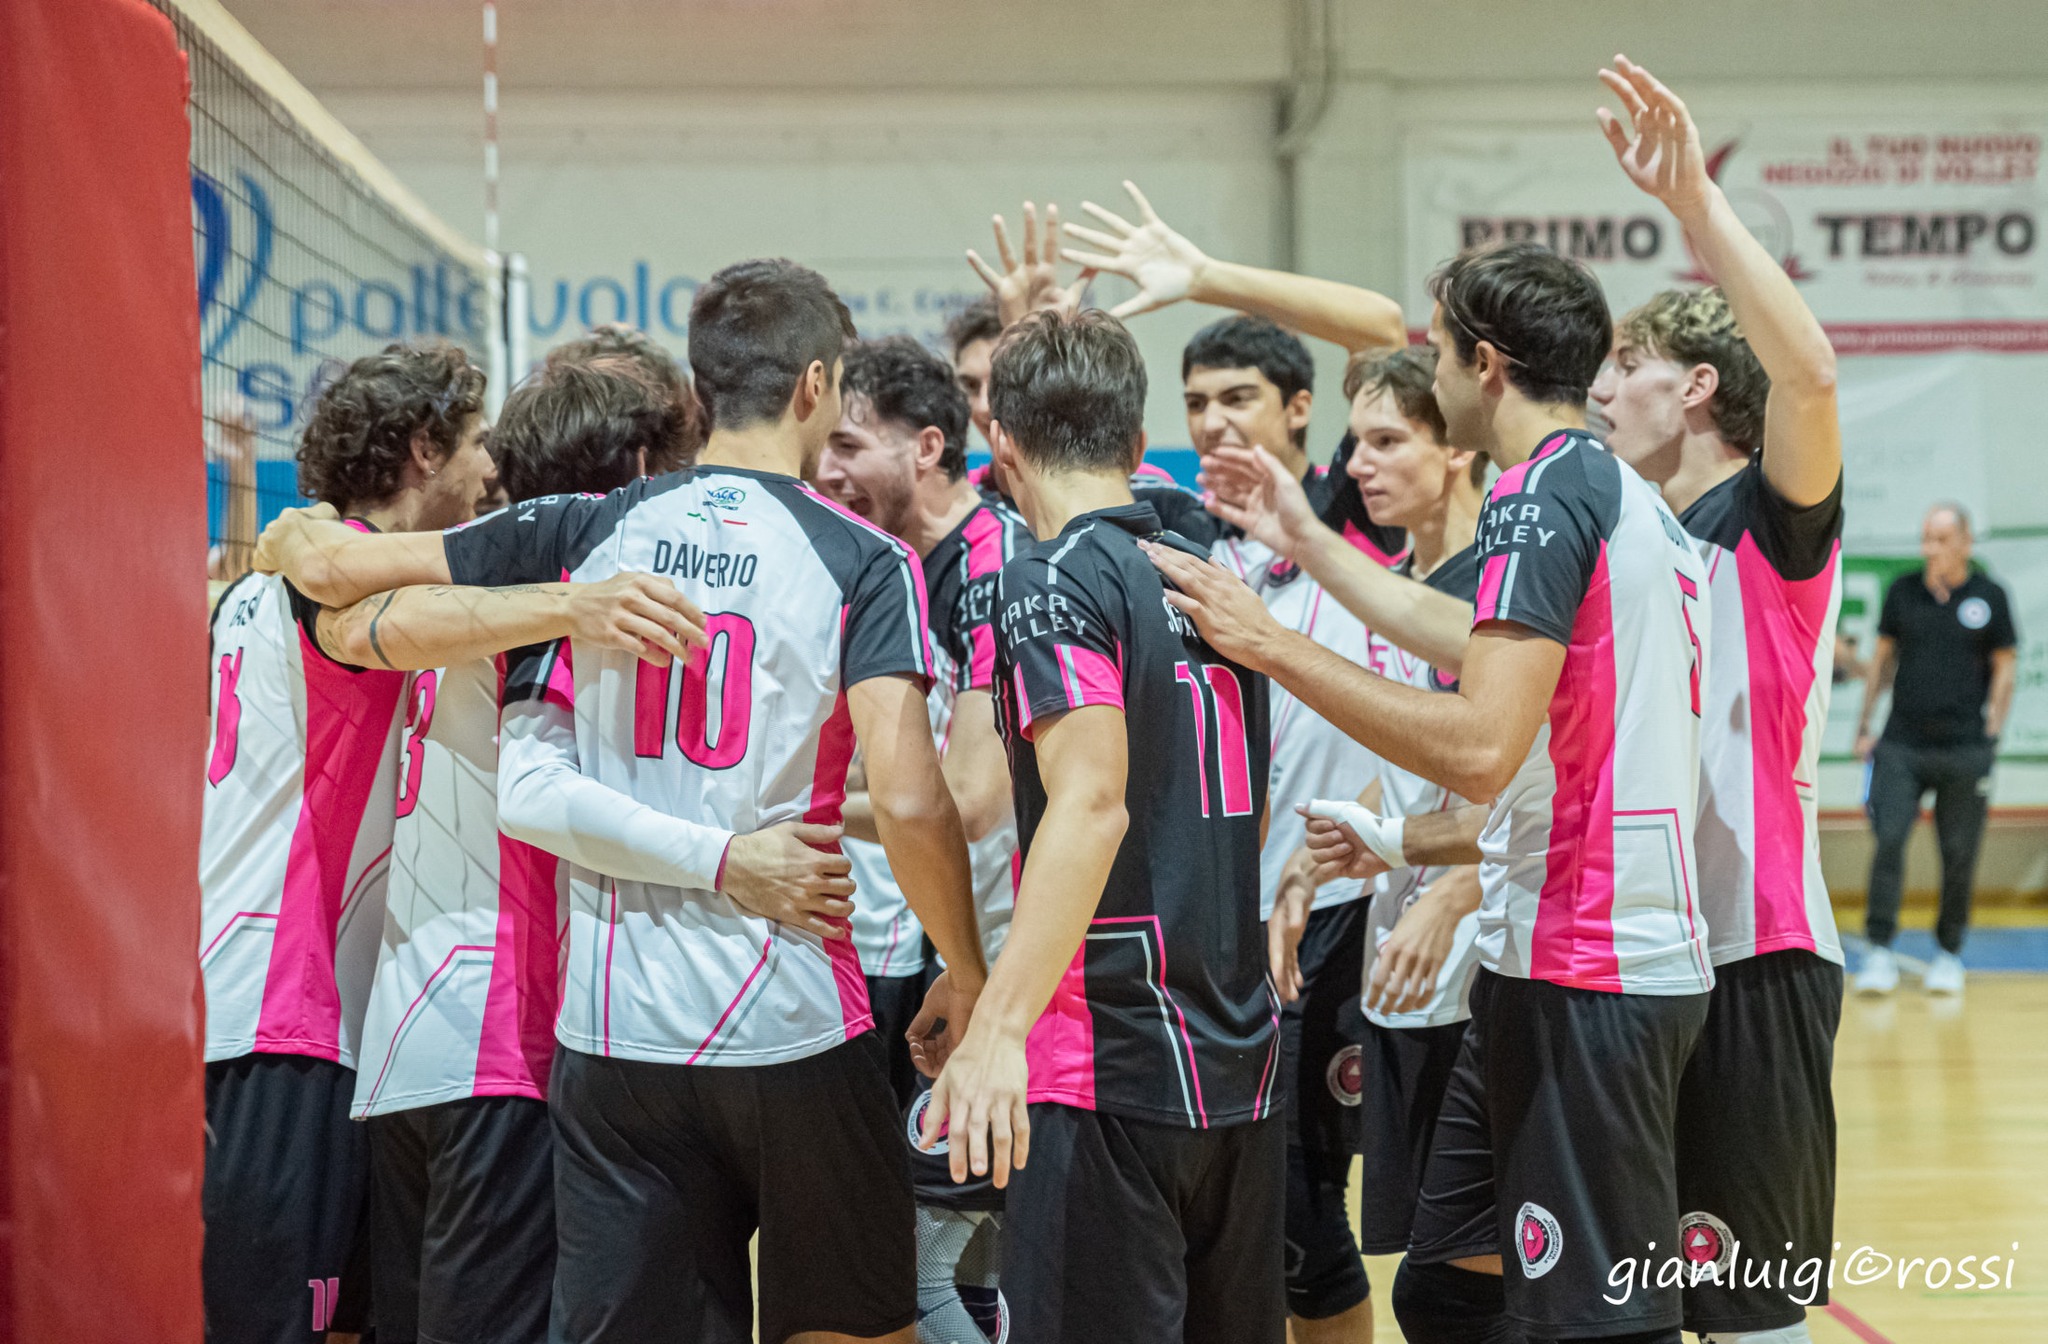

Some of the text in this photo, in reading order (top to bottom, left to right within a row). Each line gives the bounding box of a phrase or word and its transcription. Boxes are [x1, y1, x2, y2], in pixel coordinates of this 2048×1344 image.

[1815, 211, 2036, 259] TEMPO
[652, 539, 758, 588] DAVERIO
[1476, 525, 1557, 560] LLEY
[1007, 613, 1086, 650] LLEY
[634, 610, 757, 772] 10
[1174, 660, 1254, 819] 11
